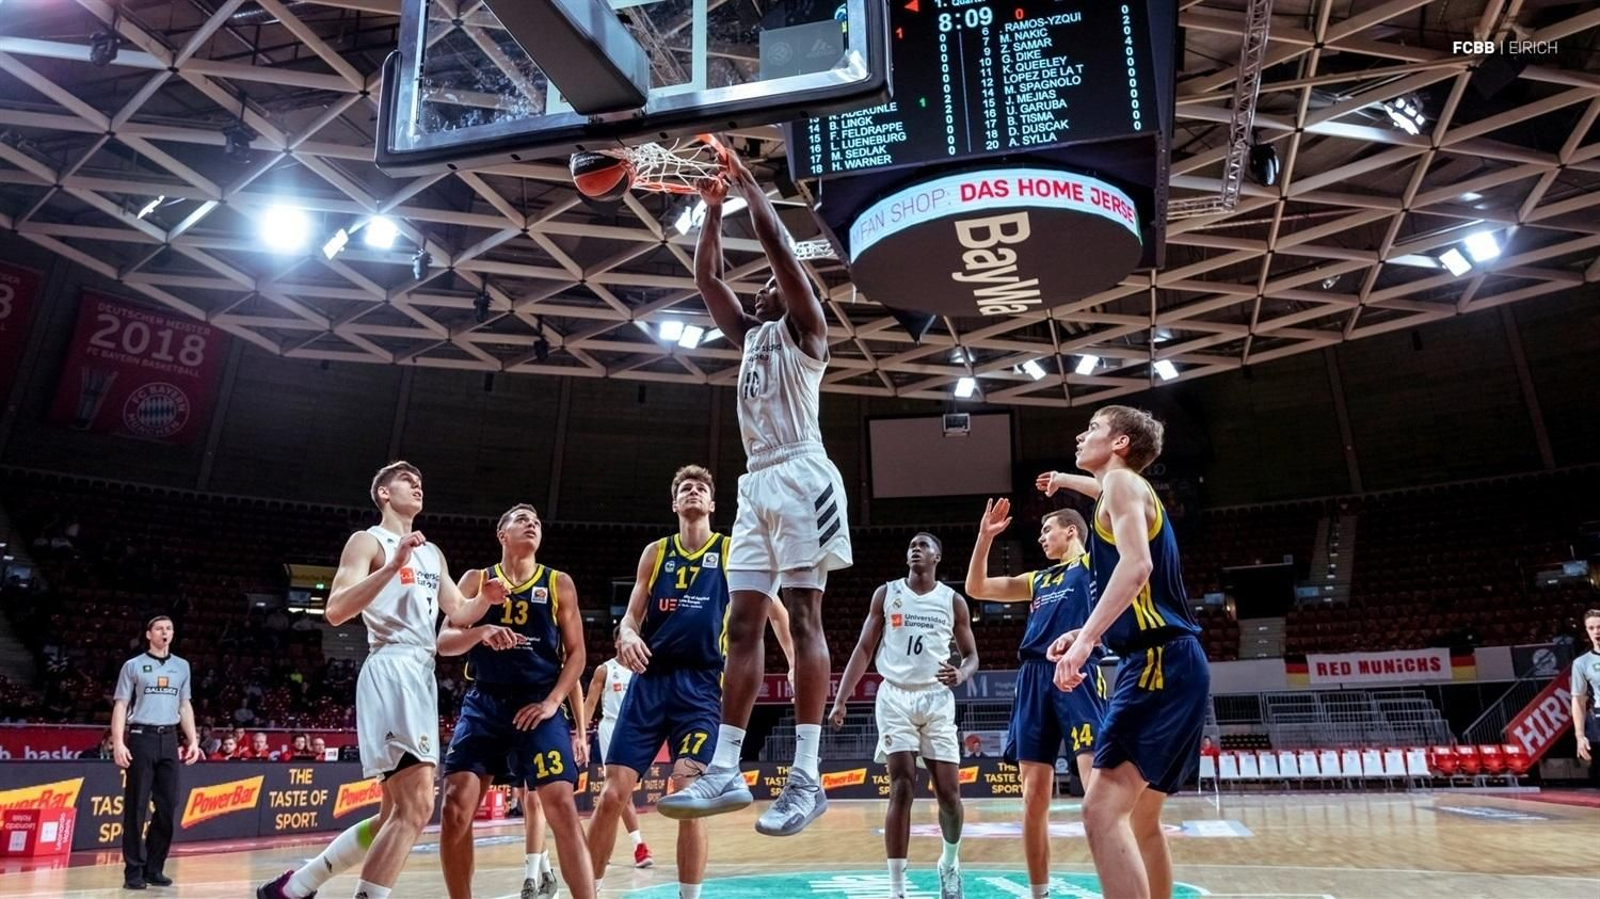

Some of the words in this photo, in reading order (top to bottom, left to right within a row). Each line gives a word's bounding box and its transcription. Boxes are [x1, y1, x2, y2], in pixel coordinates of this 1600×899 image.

[939, 6, 993, 32] 8:09
[1015, 8, 1024, 20] 0
[1121, 5, 1129, 14] 0
[896, 27, 902, 38] 1
[940, 34, 946, 42] 0
[983, 37, 990, 46] 7
[1000, 34, 1012, 43] M.
[1015, 28, 1048, 41] NAKIC
[1122, 16, 1130, 24] 2
[984, 47, 990, 56] 9
[1001, 45, 1010, 53] Z.
[1013, 38, 1052, 52] SAMAR
[1123, 26, 1131, 35] 0
[940, 44, 947, 52] 0
[941, 54, 948, 62] 0
[979, 58, 991, 66] 10
[1002, 55, 1013, 64] G.
[1016, 50, 1041, 62] DIKE
[1125, 36, 1132, 45] 4
[980, 68, 991, 76] 11
[1002, 65, 1013, 74] K.
[1015, 56, 1067, 72] QUEELEY
[1126, 47, 1133, 56] 0
[942, 64, 949, 72] 0
[942, 74, 950, 83] 0
[981, 78, 994, 87] 12
[1004, 70, 1039, 84] LOPEZ
[1042, 68, 1057, 78] DE
[1060, 66, 1074, 76] LA
[1076, 64, 1084, 74] T
[1127, 57, 1134, 66] 0
[943, 84, 950, 93] 0
[982, 89, 994, 98] 14
[1005, 86, 1016, 95] M.
[1019, 76, 1081, 92] SPAGNOLO
[1128, 68, 1135, 77] 0
[983, 100, 995, 108] 15
[1005, 97, 1014, 105] J.
[1017, 90, 1056, 103] MEJIAS
[1129, 78, 1136, 87] 0
[919, 98, 926, 107] 1
[944, 94, 951, 103] 2
[984, 110, 996, 118] 16
[1006, 106, 1017, 115] U.
[1020, 99, 1067, 114] GARUBA
[1130, 89, 1138, 98] 0
[808, 125, 820, 133] 14
[830, 121, 839, 130] B.
[841, 116, 873, 128] LINGK
[945, 105, 952, 113] 2
[985, 120, 997, 129] 17
[1008, 117, 1017, 126] B.
[1020, 112, 1054, 124] TISMA
[1132, 100, 1139, 108] 0
[986, 130, 998, 139] 18
[1008, 127, 1019, 136] D.
[1133, 110, 1140, 119] 0
[809, 135, 821, 143] 15
[830, 132, 839, 140] F.
[842, 122, 903, 138] FELDRAPPE
[946, 115, 953, 124] 0
[810, 145, 821, 153] 16
[831, 142, 839, 150] L.
[842, 132, 907, 149] LUENEBURG
[947, 125, 954, 134] 0
[986, 140, 999, 150] 20
[1009, 137, 1019, 147] A.
[1022, 132, 1057, 145] SYLLA
[1134, 121, 1141, 130] 0
[810, 155, 821, 163] 17
[831, 152, 843, 161] M.
[845, 145, 887, 159] SEDLAK
[948, 136, 954, 144] 0
[811, 165, 823, 173] 18
[832, 162, 843, 171] H.
[844, 155, 892, 169] WARNER
[948, 146, 956, 155] 0
[860, 210, 884, 242] FAN
[891, 188, 951, 222] SHOP:
[960, 180, 1009, 202] DAS
[1018, 179, 1084, 202] HOME
[1091, 187, 1135, 224] JERSE
[952, 211, 1042, 316] BayWa
[98, 302, 164, 324] DEUTSCHER
[166, 320, 211, 335] MEISTER
[90, 314, 206, 366] 2018
[86, 346, 99, 356] FC
[102, 348, 140, 365] BAYERN
[141, 358, 199, 377] BASKETBALL
[676, 566, 700, 589] 17
[1041, 572, 1064, 588] 14
[501, 597, 529, 625] 13
[904, 614, 946, 625] Universidad
[904, 621, 934, 629] Europea
[906, 636, 923, 656] 16
[1316, 662, 1351, 676] RED
[679, 732, 708, 754] 17
[1071, 724, 1093, 751] 14
[289, 769, 313, 784] THE
[534, 750, 564, 778] 13
[764, 777, 786, 785] TAST
[823, 772, 863, 786] PowerBar
[985, 774, 1015, 782] TASTE
[190, 786, 256, 815] PowerBar
[270, 791, 308, 808] TASTE
[310, 790, 328, 806] OF
[339, 780, 384, 807] PowerBa
[275, 813, 318, 830] SPORT.
